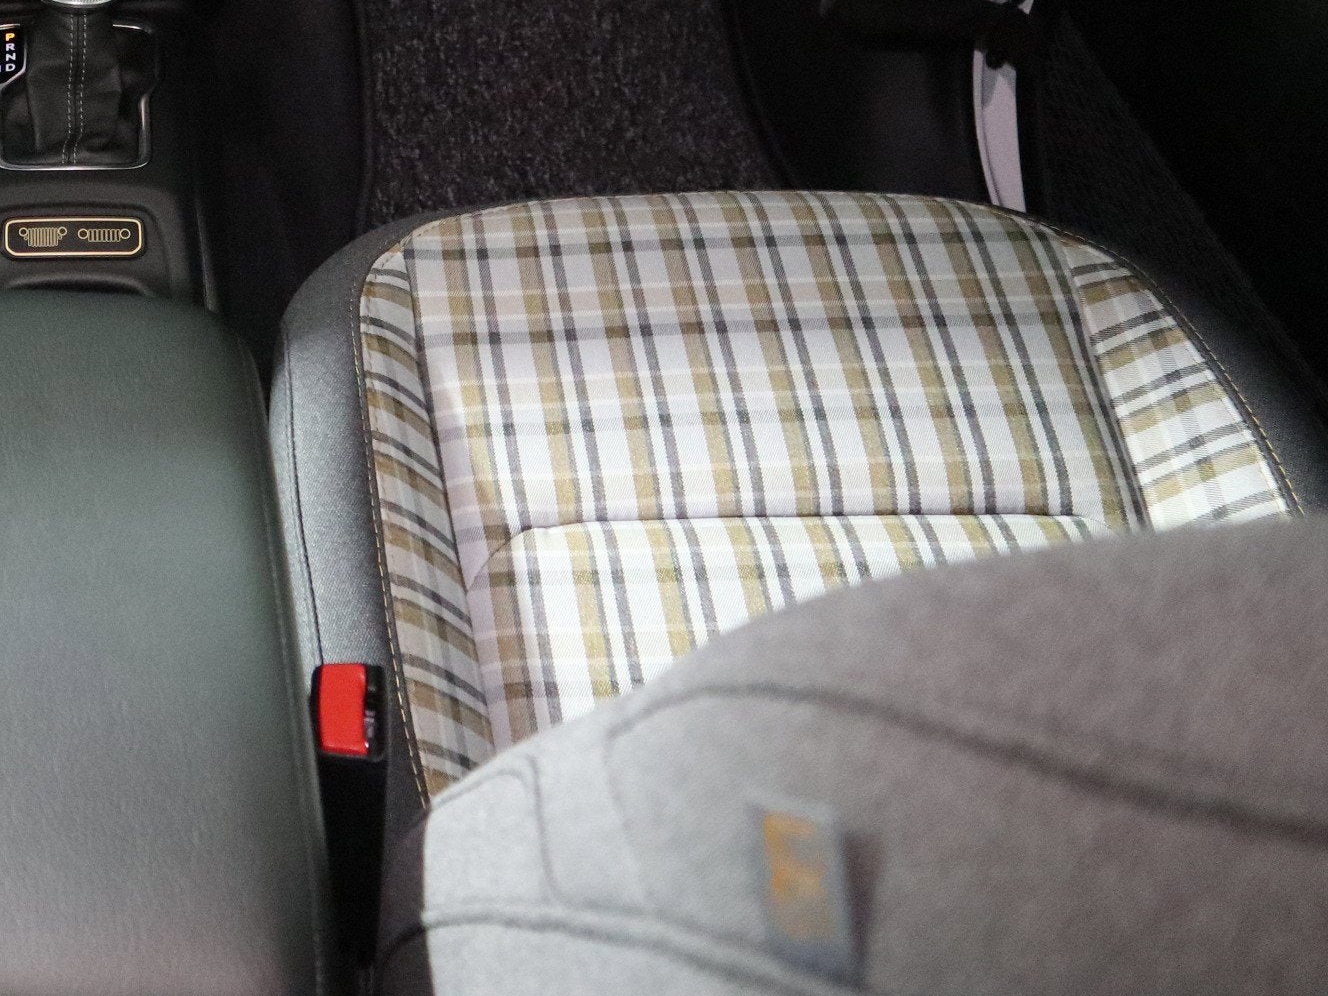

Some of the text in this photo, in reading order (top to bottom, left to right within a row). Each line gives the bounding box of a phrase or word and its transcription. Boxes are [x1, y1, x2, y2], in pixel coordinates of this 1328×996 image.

[5, 32, 15, 41] P
[5, 42, 15, 51] R
[5, 53, 16, 62] N
[5, 63, 16, 72] D
